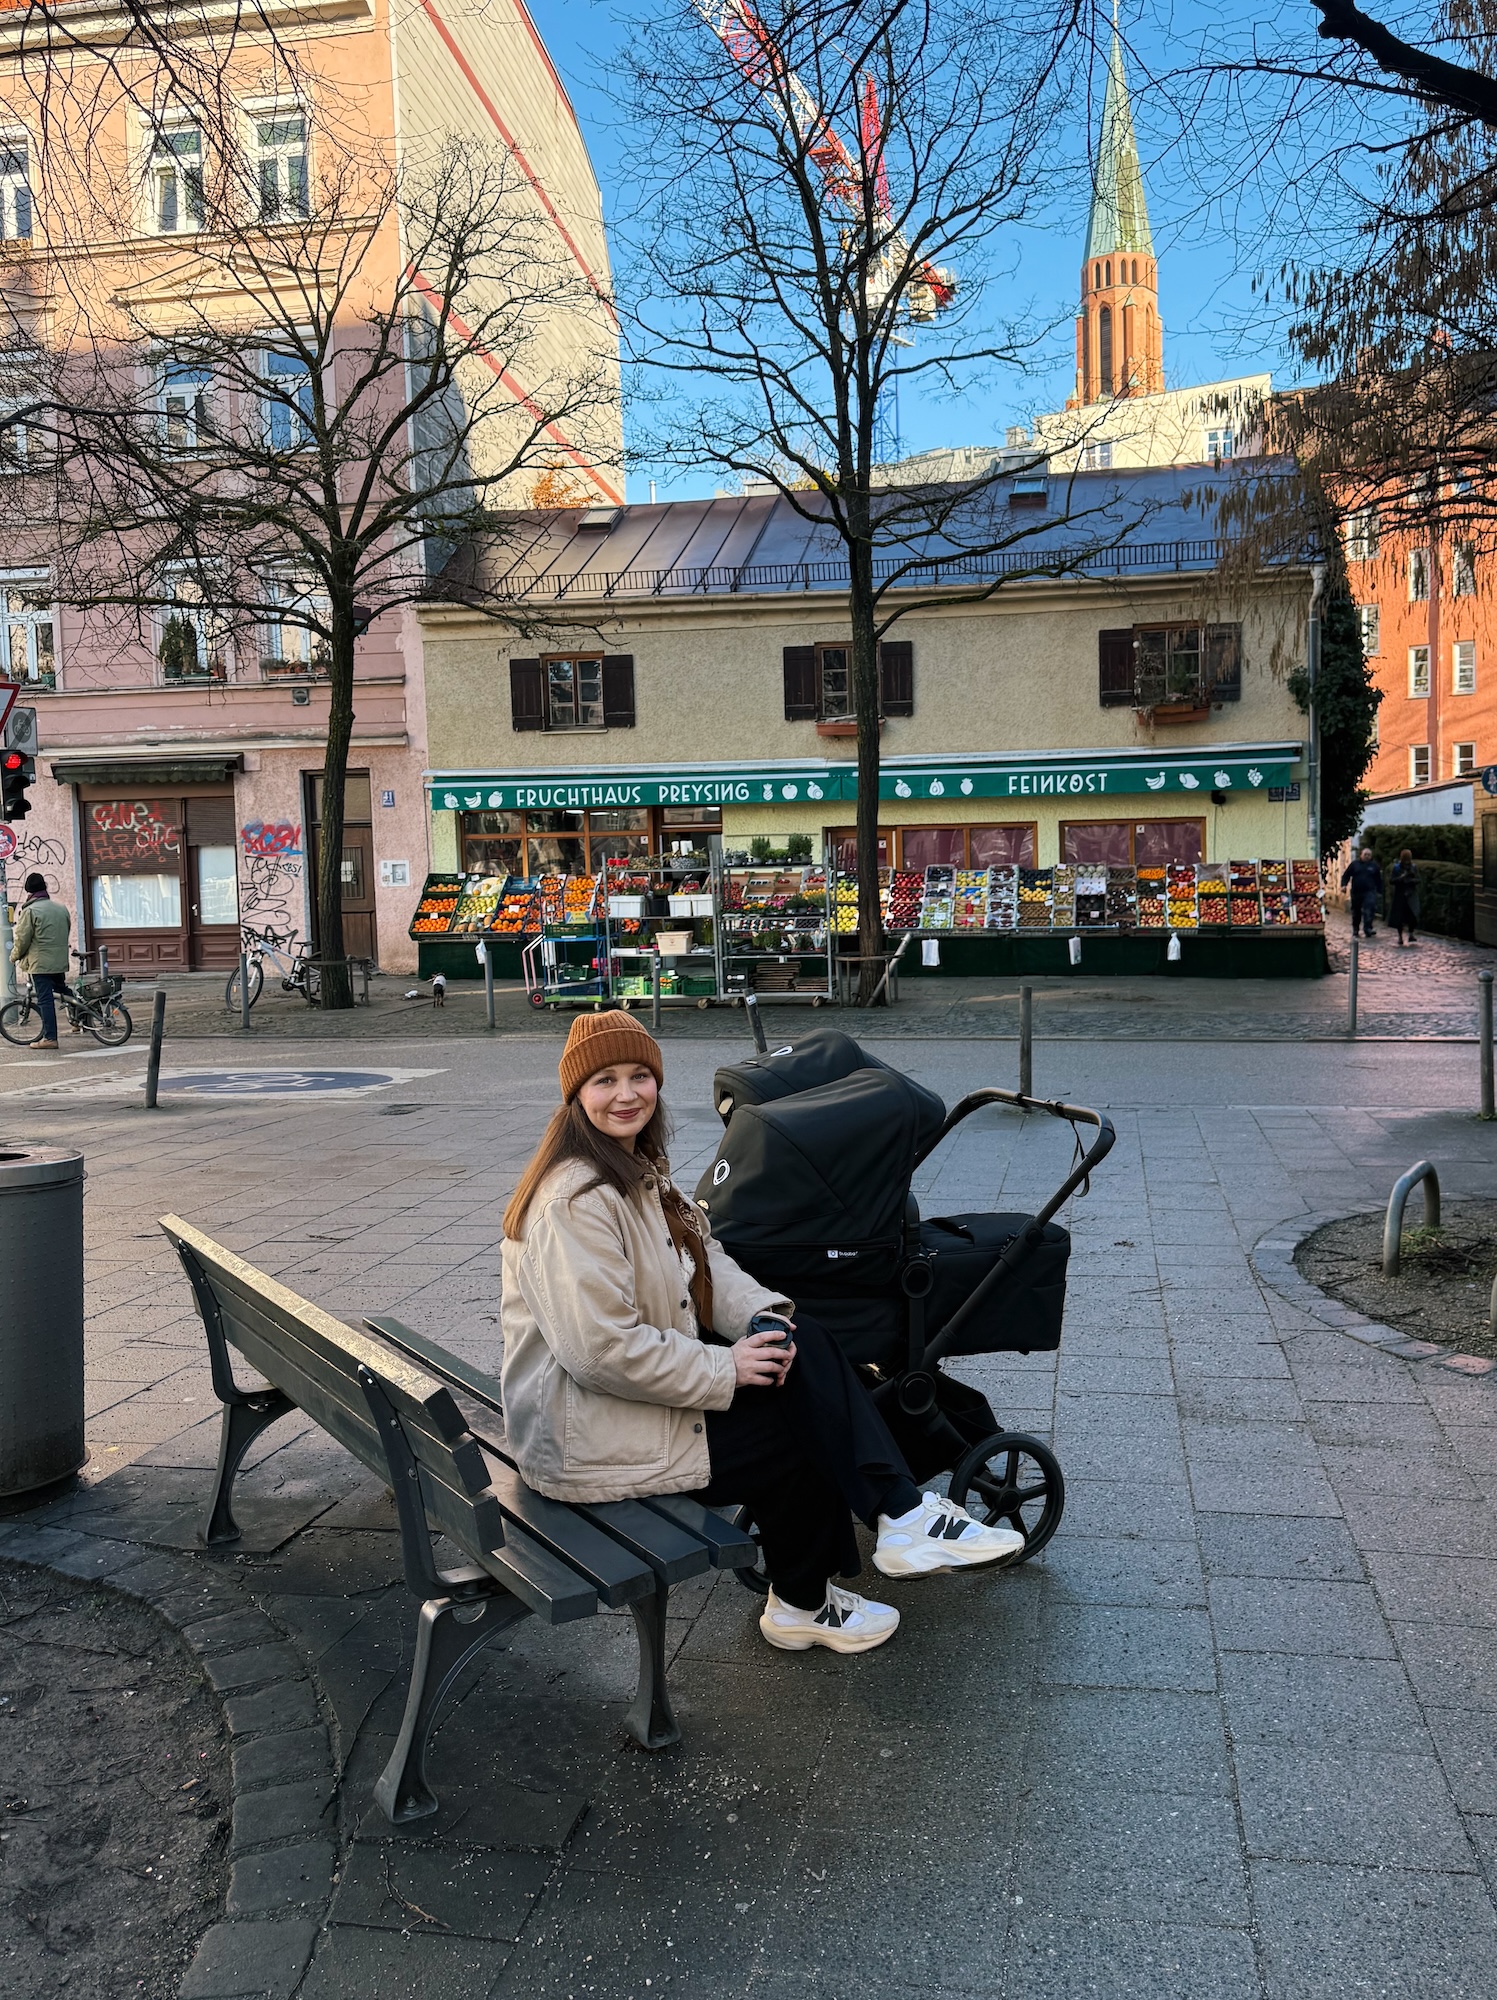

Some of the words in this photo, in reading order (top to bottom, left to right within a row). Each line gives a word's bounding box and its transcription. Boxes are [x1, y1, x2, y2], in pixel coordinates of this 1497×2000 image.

[516, 785, 641, 807] FRUCHTHAUS
[658, 782, 750, 803] PREYSING
[1008, 772, 1108, 794] FEINKOST
